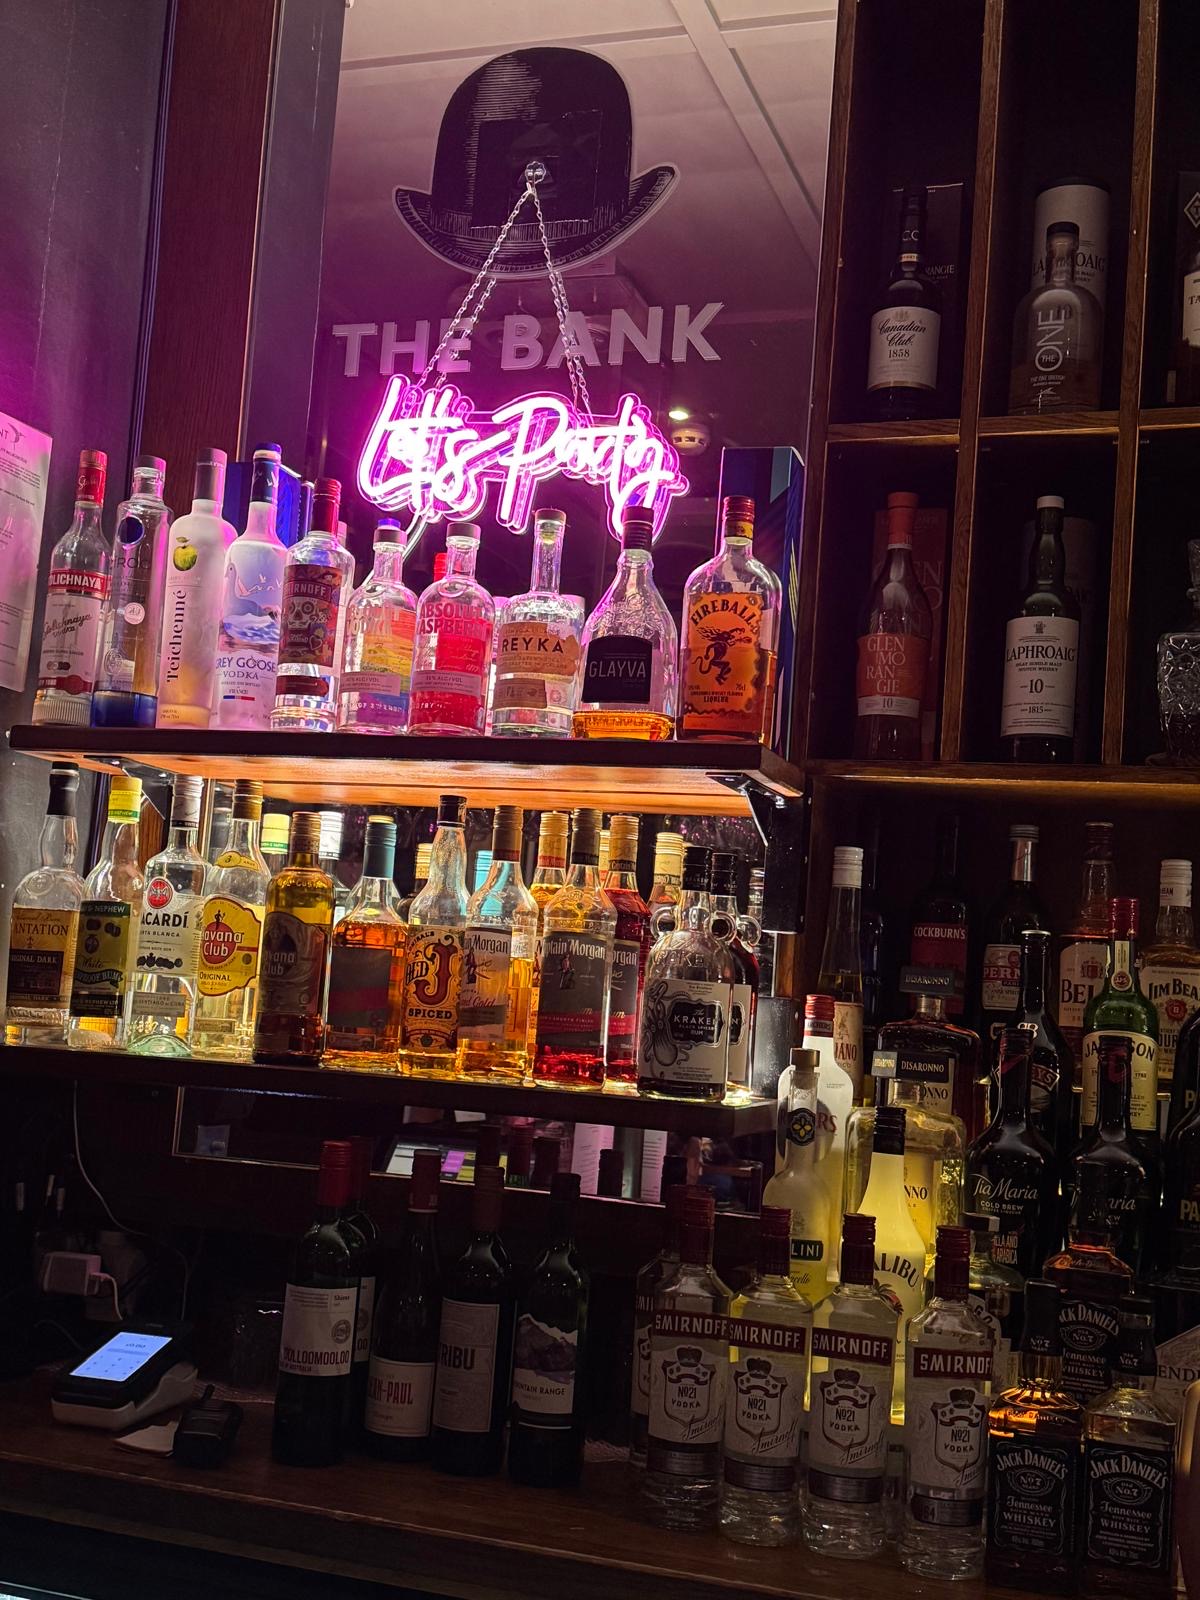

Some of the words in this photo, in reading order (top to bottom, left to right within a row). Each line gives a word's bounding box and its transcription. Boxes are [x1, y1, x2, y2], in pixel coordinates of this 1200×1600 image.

[878, 319, 927, 336] Canadian
[332, 317, 474, 377] THE
[500, 302, 725, 371] BANK
[886, 331, 913, 348] Club
[1035, 309, 1066, 372] ONE
[888, 349, 910, 359] 1858
[358, 376, 510, 520] Let's
[490, 390, 678, 540] Party
[690, 599, 756, 628] FIREBALL
[166, 589, 187, 683] Teichenné
[867, 636, 904, 651] GLEN
[502, 637, 563, 653] REYKA
[1006, 644, 1075, 662] LAPHROAIG
[236, 656, 276, 673] GOOSE
[876, 651, 906, 666] MO
[223, 671, 259, 680] VODKA
[589, 661, 646, 678] GLAYVA
[866, 665, 896, 680] RAN
[876, 679, 899, 694] GIE
[1029, 679, 1044, 693] 10
[1028, 706, 1044, 714] 1815
[203, 930, 244, 943] avana
[913, 927, 967, 940] COCKBURN'S
[203, 942, 229, 957] Club
[473, 934, 509, 954] Morgan
[568, 939, 606, 959] Morgan
[612, 950, 638, 966] organ
[200, 971, 232, 982] ORIGINAL
[473, 997, 496, 1008] Gold
[408, 1008, 453, 1020] SPICED
[901, 1061, 945, 1073] DISARONNO
[969, 1174, 994, 1197] Tia
[989, 1177, 1038, 1200] Maria
[980, 1200, 1000, 1209] COLD
[1001, 1203, 1024, 1211] BREW
[1106, 1195, 1136, 1211] aria
[655, 1314, 728, 1336] SMIRNOFF
[729, 1324, 800, 1347] SMIRNOFF
[813, 1334, 888, 1359] SMIRNOFF
[539, 1387, 566, 1396] RANGE
[672, 1399, 700, 1409] VODKA
[742, 1410, 771, 1421] VODKA
[829, 1422, 860, 1431] VODKA
[944, 1443, 974, 1452] VODKA
[995, 1452, 1022, 1472] JACK
[1024, 1449, 1069, 1481] DANIEL'S
[1090, 1458, 1119, 1479] JACK
[1121, 1455, 1169, 1490] DANIEL'S
[1006, 1495, 1053, 1513] Tennessee
[1100, 1501, 1153, 1519] Tennessee
[1002, 1511, 1056, 1528] WHISKEY
[1100, 1518, 1151, 1534] WHISKEY
